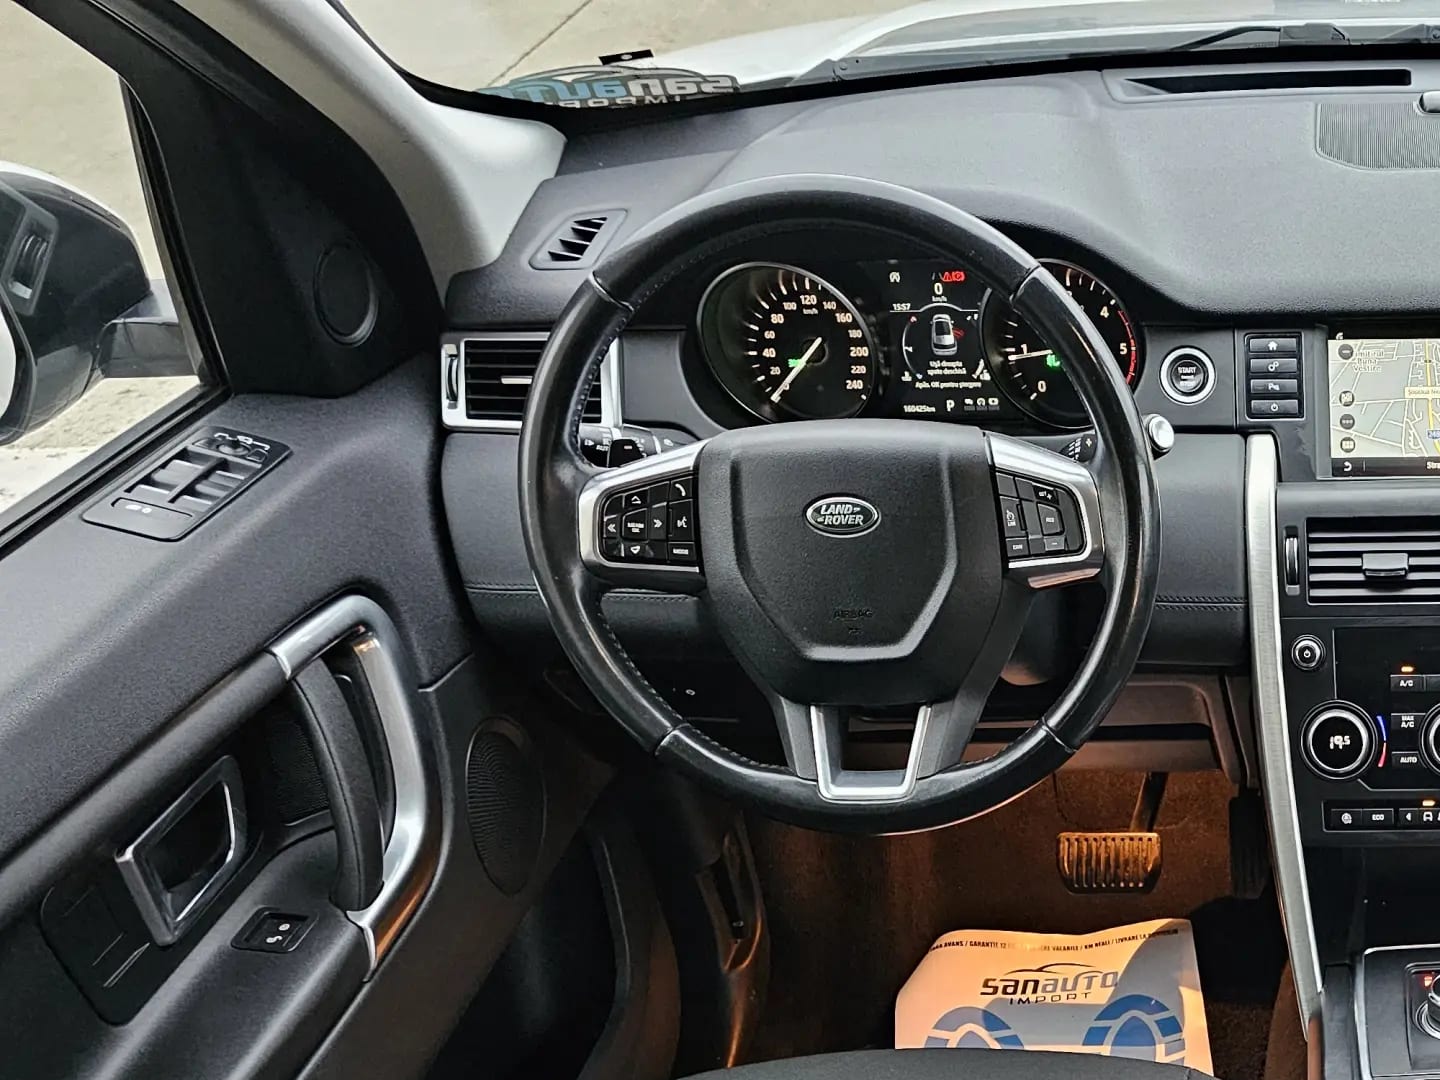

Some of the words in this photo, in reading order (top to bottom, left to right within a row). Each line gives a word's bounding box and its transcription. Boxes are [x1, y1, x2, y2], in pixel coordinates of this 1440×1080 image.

[800, 295, 817, 305] 120
[783, 302, 797, 310] 100
[823, 301, 837, 309] 140
[1100, 306, 1109, 318] 4
[771, 313, 784, 323] 80
[836, 313, 852, 322] 160
[764, 331, 775, 339] 60
[848, 329, 862, 338] 180
[762, 349, 776, 357] 40
[850, 347, 869, 356] 200
[1119, 343, 1127, 354] 5
[770, 367, 781, 375] 20
[851, 365, 867, 374] 220
[846, 380, 863, 389] 240
[1037, 380, 1047, 392] 0
[820, 504, 853, 515] LAND
[823, 514, 864, 525] ROVER
[1009, 991, 1091, 1005] IMPORT
